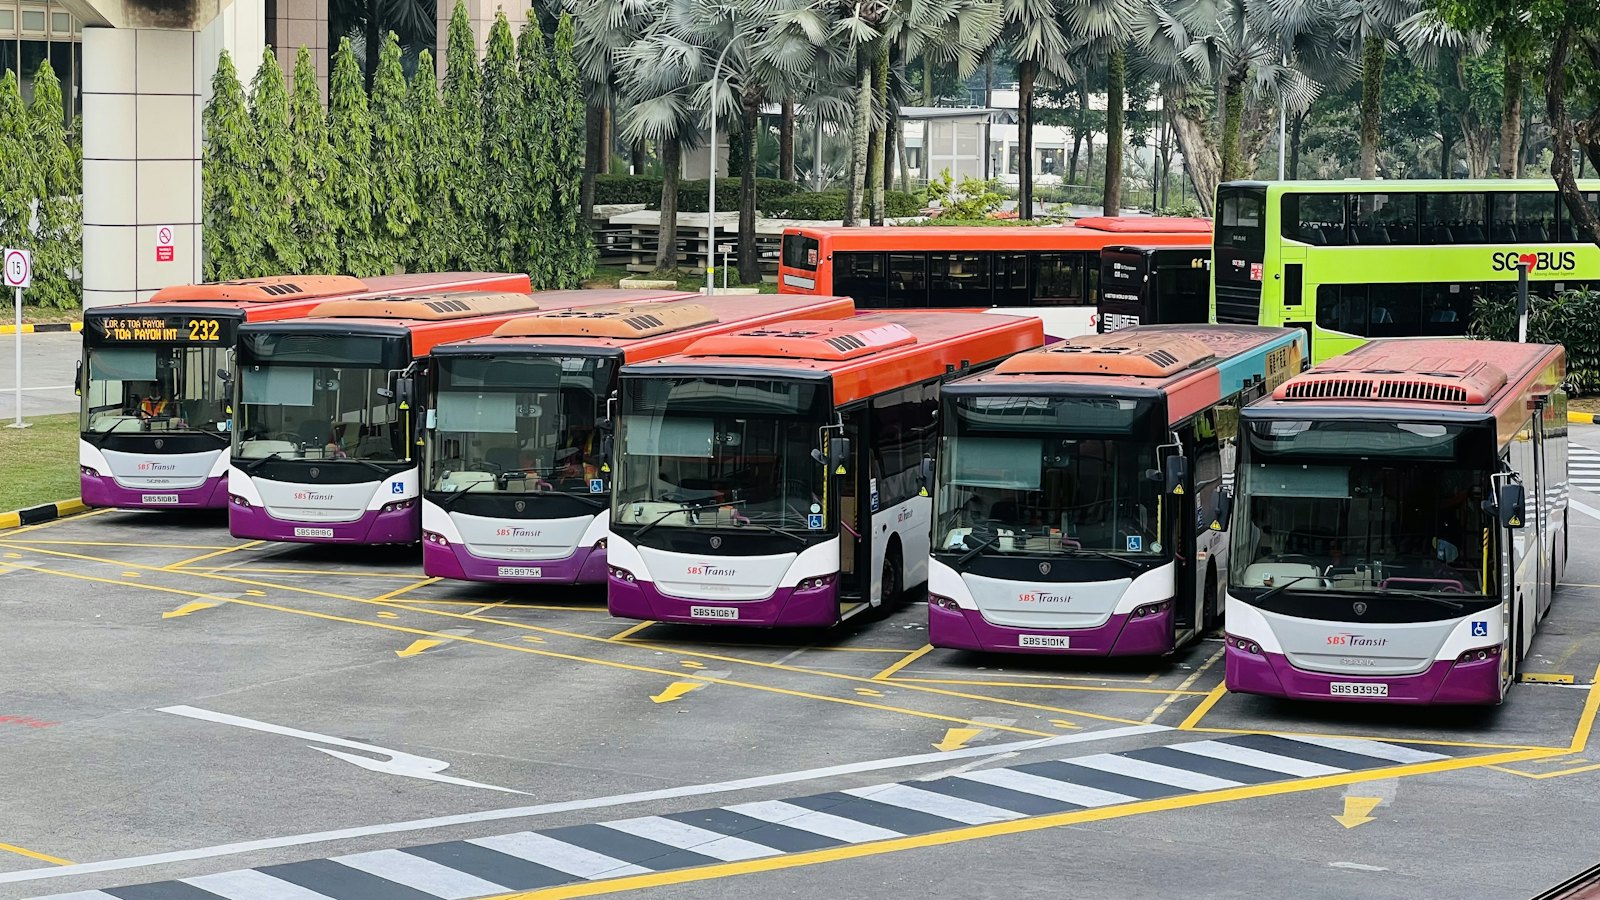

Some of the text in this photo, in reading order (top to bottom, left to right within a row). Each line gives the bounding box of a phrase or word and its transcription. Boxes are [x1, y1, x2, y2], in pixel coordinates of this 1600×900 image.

[12, 261, 21, 275] 15
[104, 320, 165, 328] LOR 6 TOA PAYOH
[114, 329, 177, 340] TOA PAYOH INT
[188, 320, 219, 340] 232
[150, 463, 176, 471] Transit
[294, 492, 334, 501] SBS Transit
[511, 527, 542, 537] Transit
[687, 566, 736, 576] SBS Transit
[1019, 592, 1072, 603] SBS Transit
[1327, 634, 1389, 647] SBS Transit
